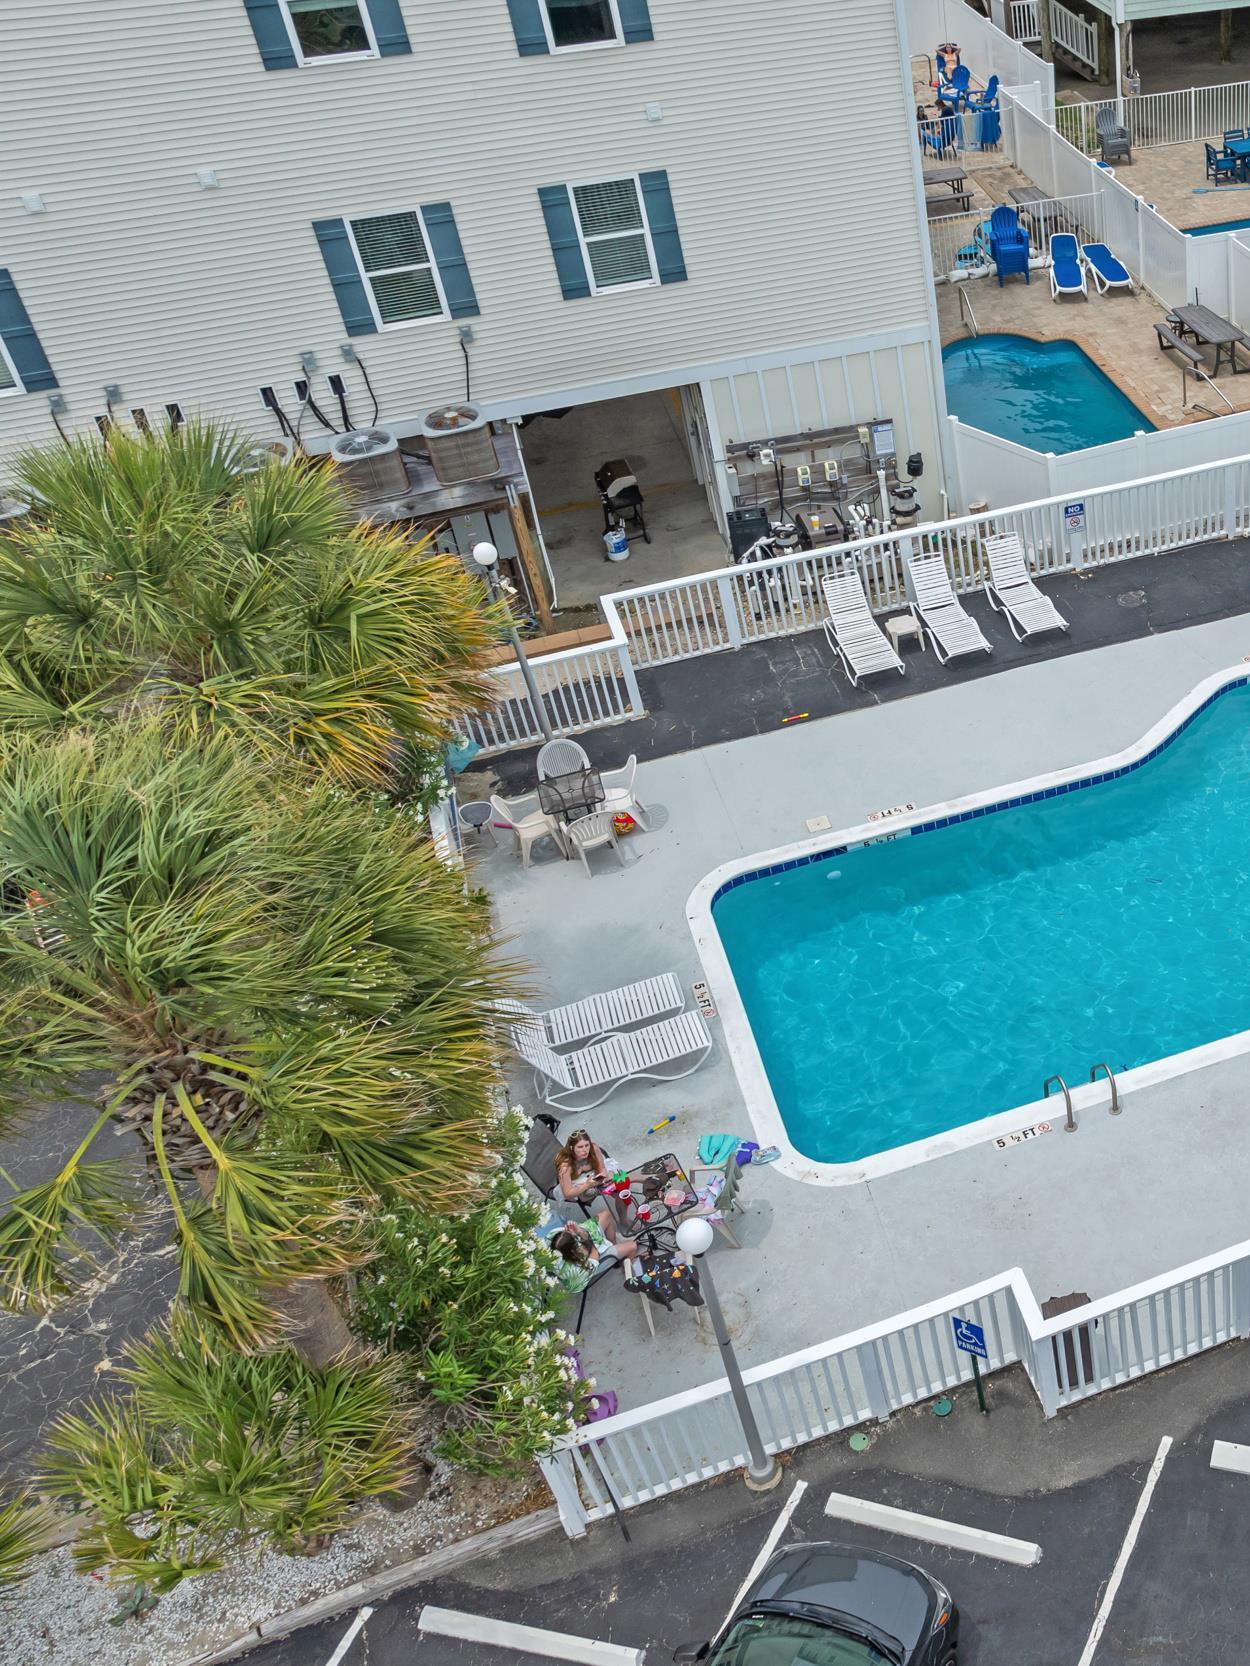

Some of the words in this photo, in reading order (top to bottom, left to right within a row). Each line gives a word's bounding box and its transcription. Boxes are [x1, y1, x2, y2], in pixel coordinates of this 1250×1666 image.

[1068, 505, 1080, 514] NO
[886, 833, 897, 842] FT
[694, 982, 705, 990] 5
[699, 998, 712, 1009] FT
[996, 1138, 1006, 1148] 5
[1022, 1127, 1036, 1140] FT
[957, 1338, 987, 1356] PARKING
